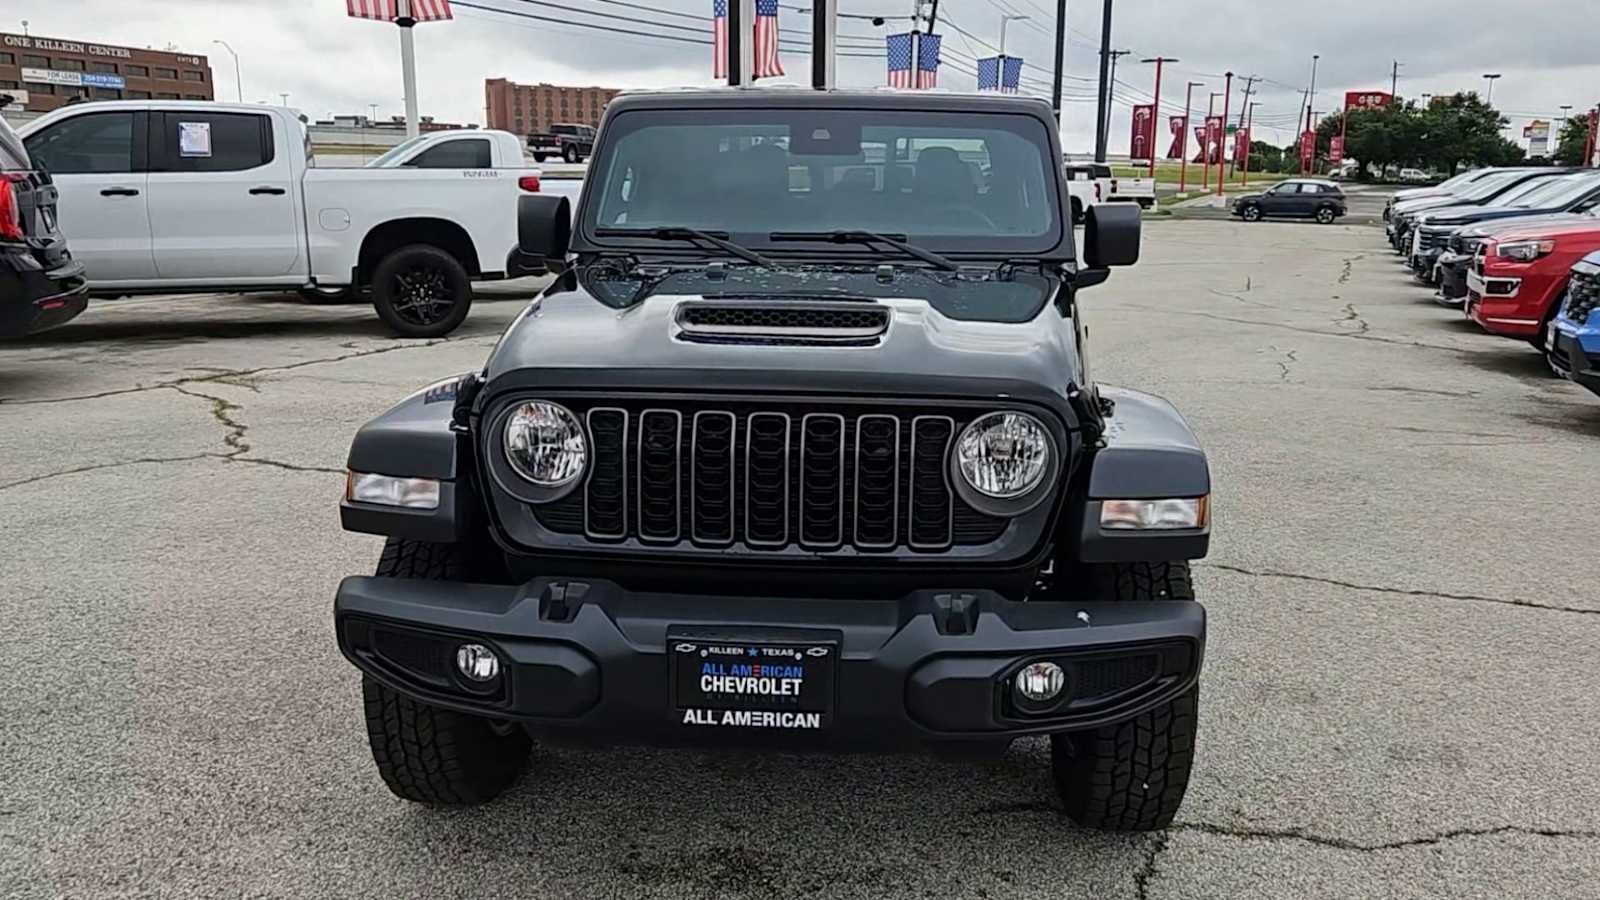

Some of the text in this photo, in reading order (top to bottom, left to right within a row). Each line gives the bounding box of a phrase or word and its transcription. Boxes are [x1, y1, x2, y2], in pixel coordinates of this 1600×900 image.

[4, 36, 131, 58] ONE KILLEEN CENTER
[709, 647, 795, 657] KILLEEN TEXAS
[702, 663, 802, 678] ALL AMERICAN
[701, 675, 803, 696] CHEVROLET
[683, 709, 821, 729] ALL AMERICAN
